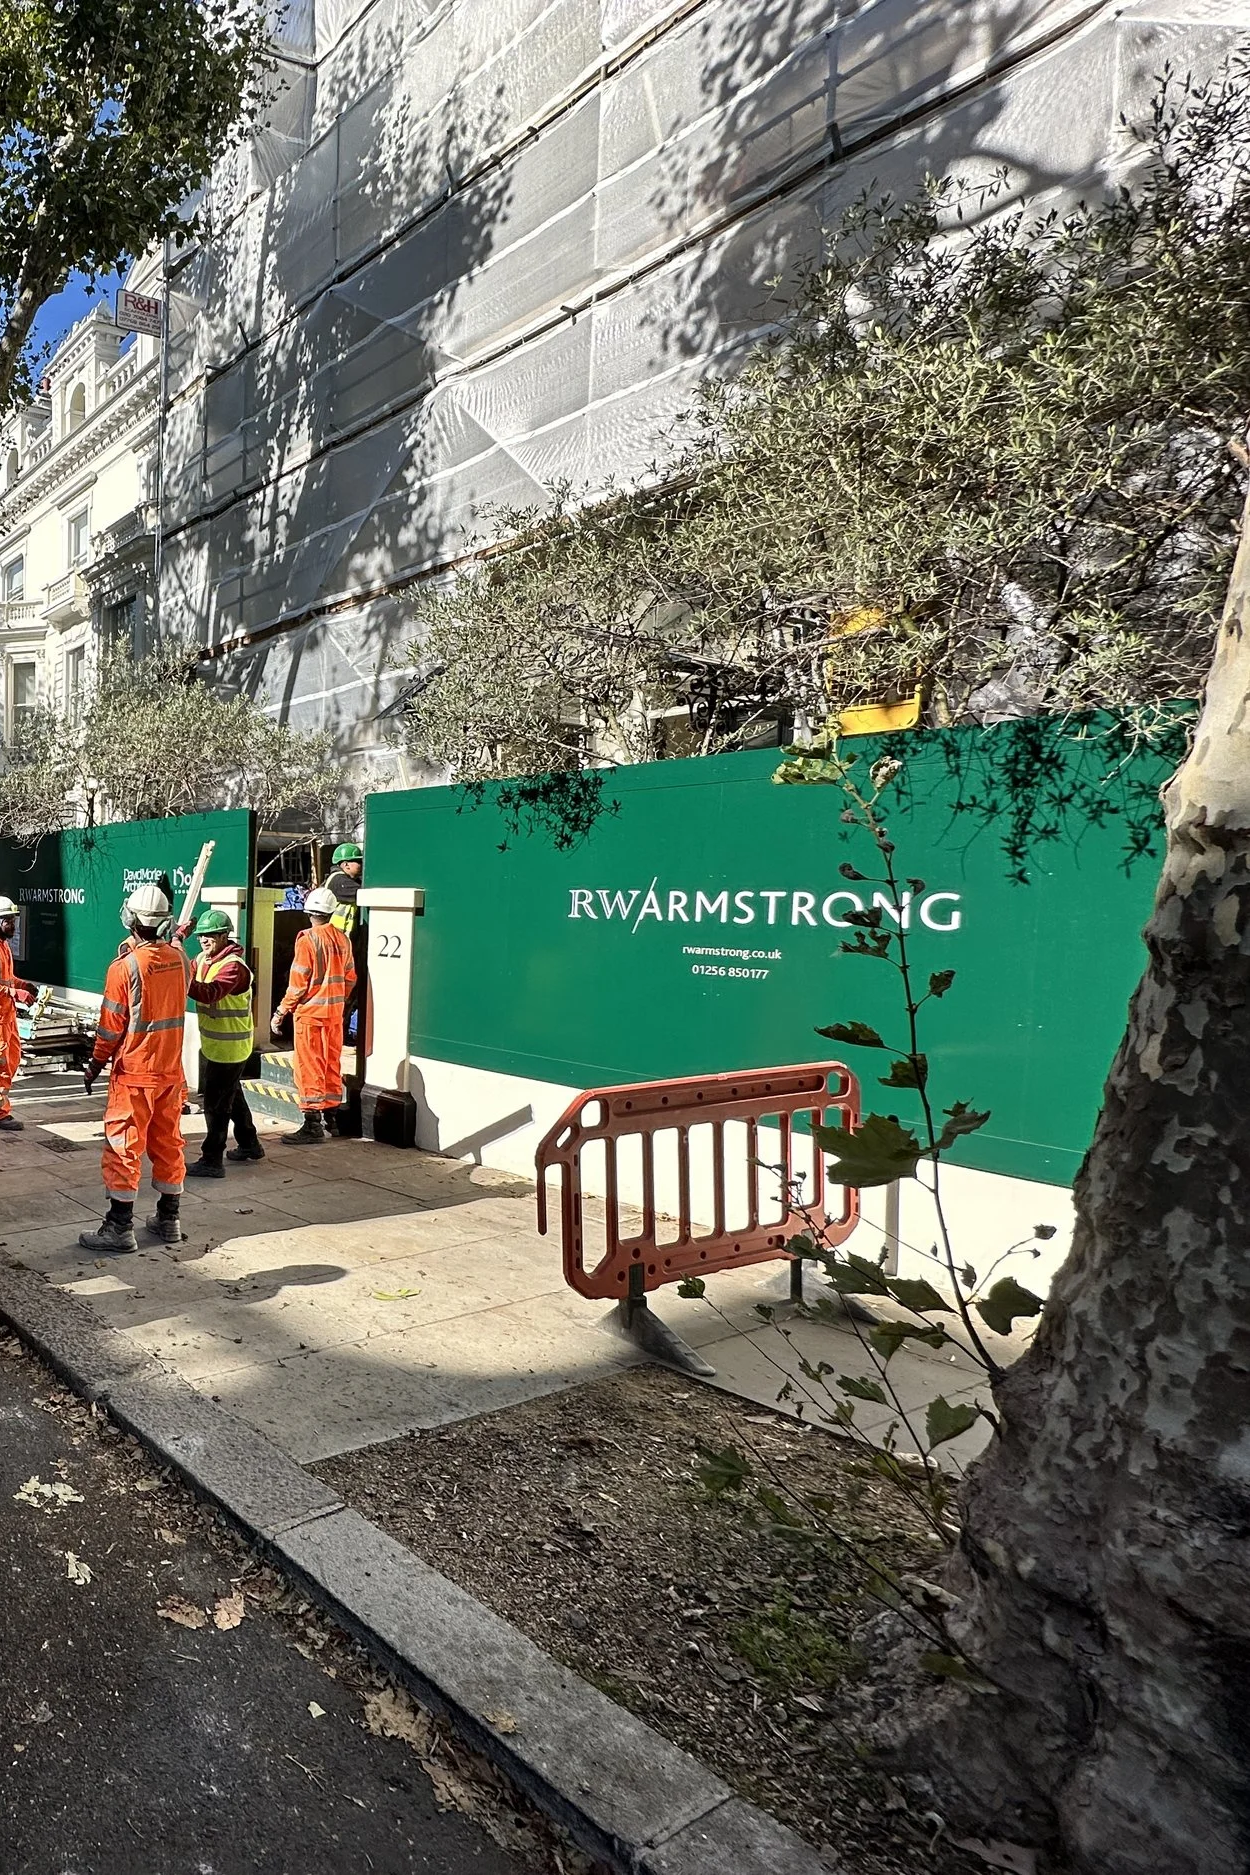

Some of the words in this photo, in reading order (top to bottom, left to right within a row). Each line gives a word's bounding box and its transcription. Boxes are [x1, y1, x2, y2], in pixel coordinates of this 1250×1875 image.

[124, 293, 158, 315] R&H
[18, 888, 85, 904] RWARMSTRONG
[377, 935, 402, 958] 22
[682, 946, 782, 960] rwarmstrong.co.uk
[692, 964, 726, 976] 01256
[728, 967, 769, 979] 850177
